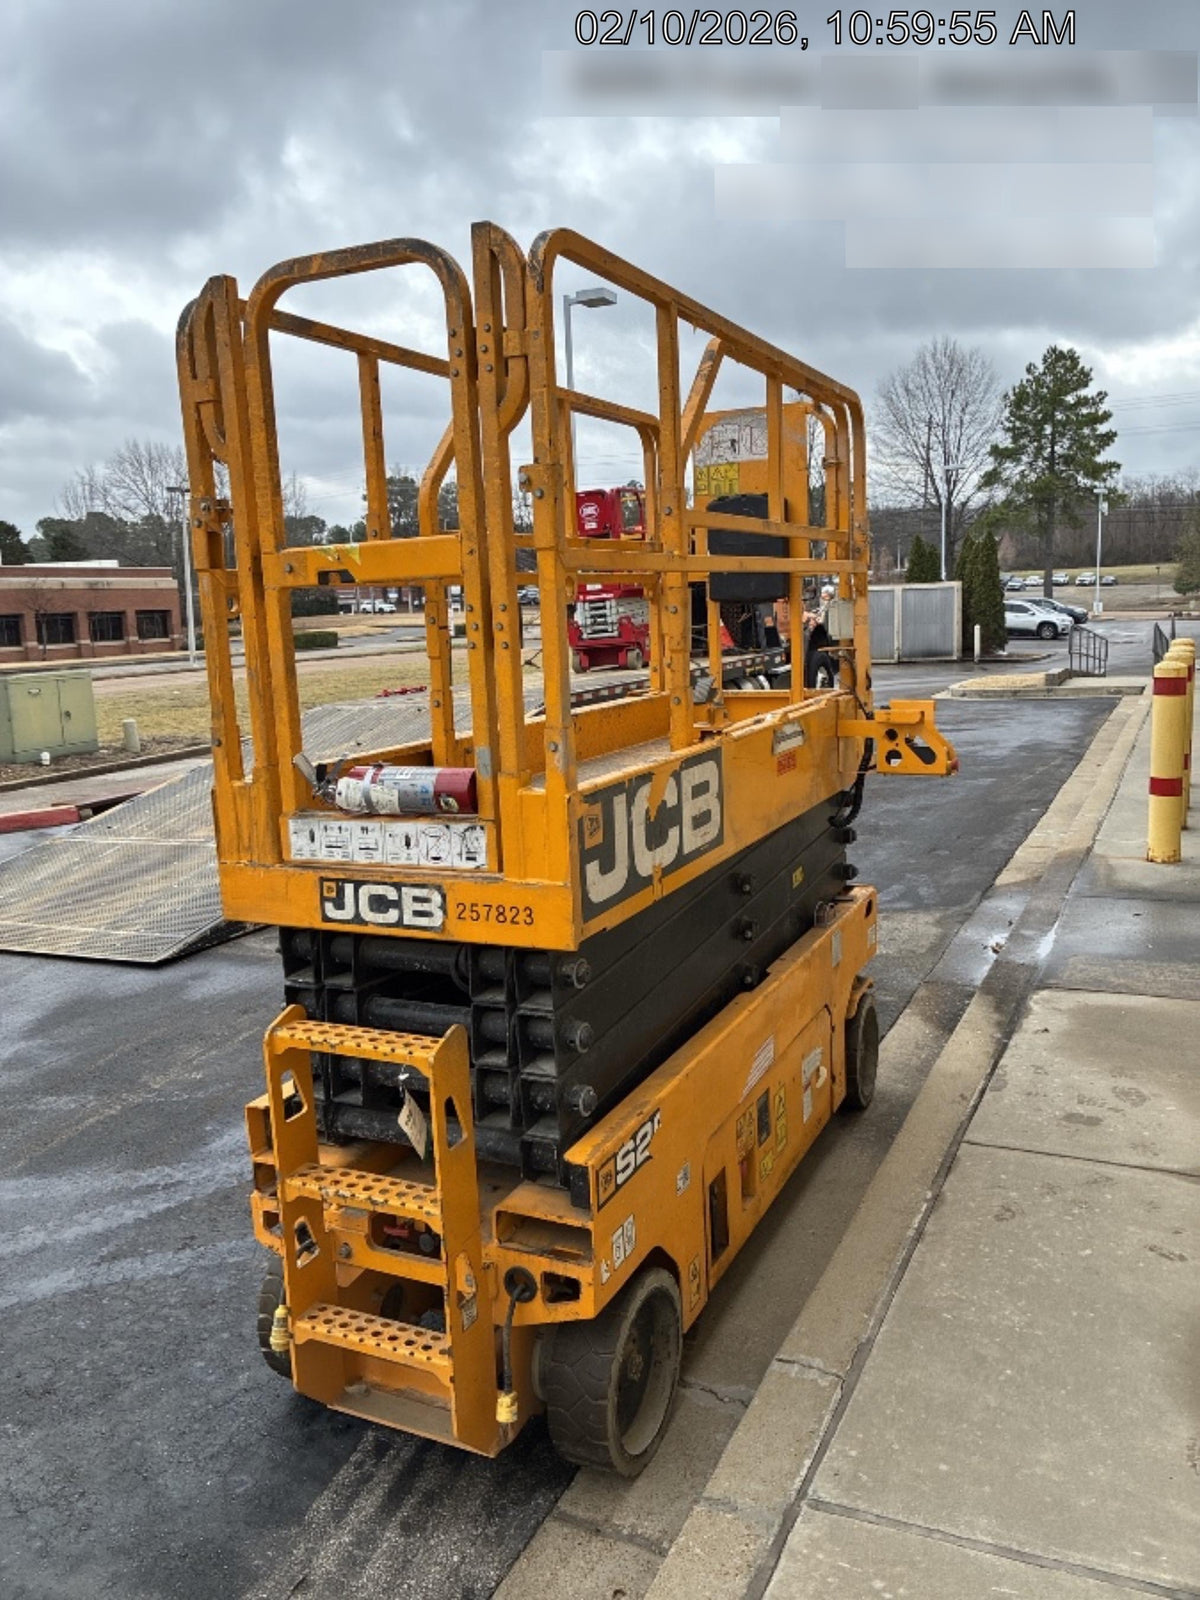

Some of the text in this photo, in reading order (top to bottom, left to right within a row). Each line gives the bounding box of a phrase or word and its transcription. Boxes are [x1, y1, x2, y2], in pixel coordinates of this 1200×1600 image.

[586, 760, 721, 903] JCB
[324, 882, 444, 927] JCB
[456, 903, 534, 925] 257823
